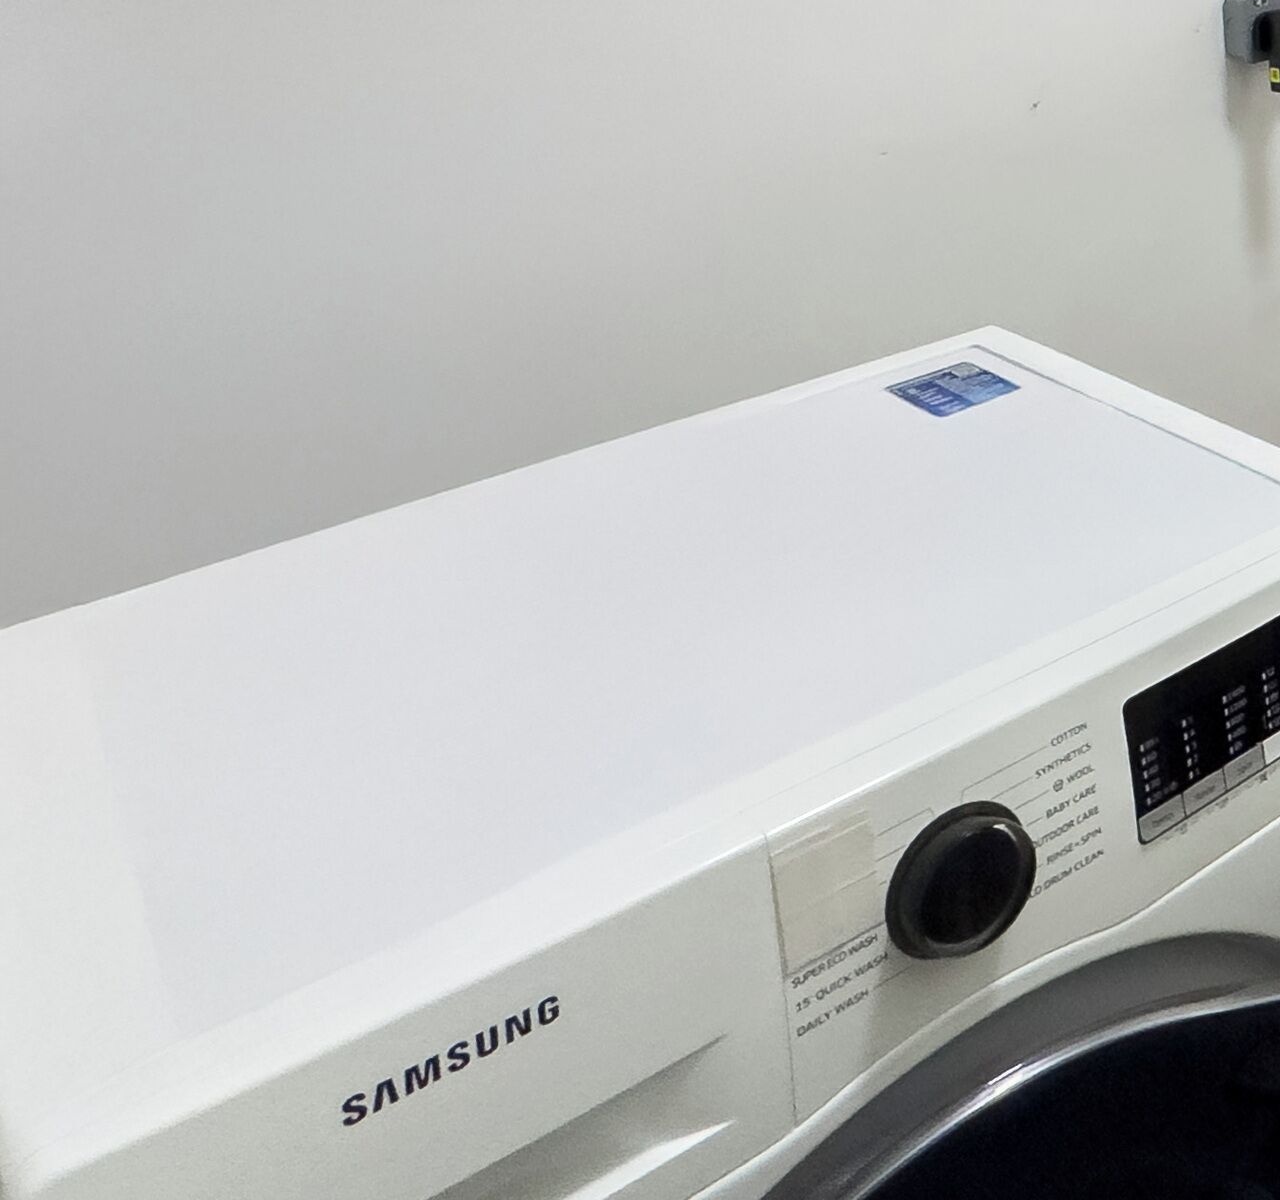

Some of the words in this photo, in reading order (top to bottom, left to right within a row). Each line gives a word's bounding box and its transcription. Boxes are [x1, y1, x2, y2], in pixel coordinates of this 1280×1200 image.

[1050, 722, 1088, 747] COTTON
[1035, 743, 1092, 780] SYNTHETICS
[1066, 765, 1095, 784] WOOL
[1046, 800, 1072, 820] BABY
[1073, 783, 1097, 804] CARE
[1076, 806, 1100, 825] CARE
[1044, 867, 1074, 892] DRUM
[1074, 849, 1105, 873] CLEAN
[791, 961, 826, 990] SUPER
[826, 951, 847, 970] ECO
[848, 933, 878, 956] WASH
[815, 972, 853, 1001] QUICK
[854, 951, 888, 977] WASH
[796, 1009, 832, 1038] DAILY
[834, 988, 869, 1015] WASH
[341, 995, 561, 1127] SAMSUNG
